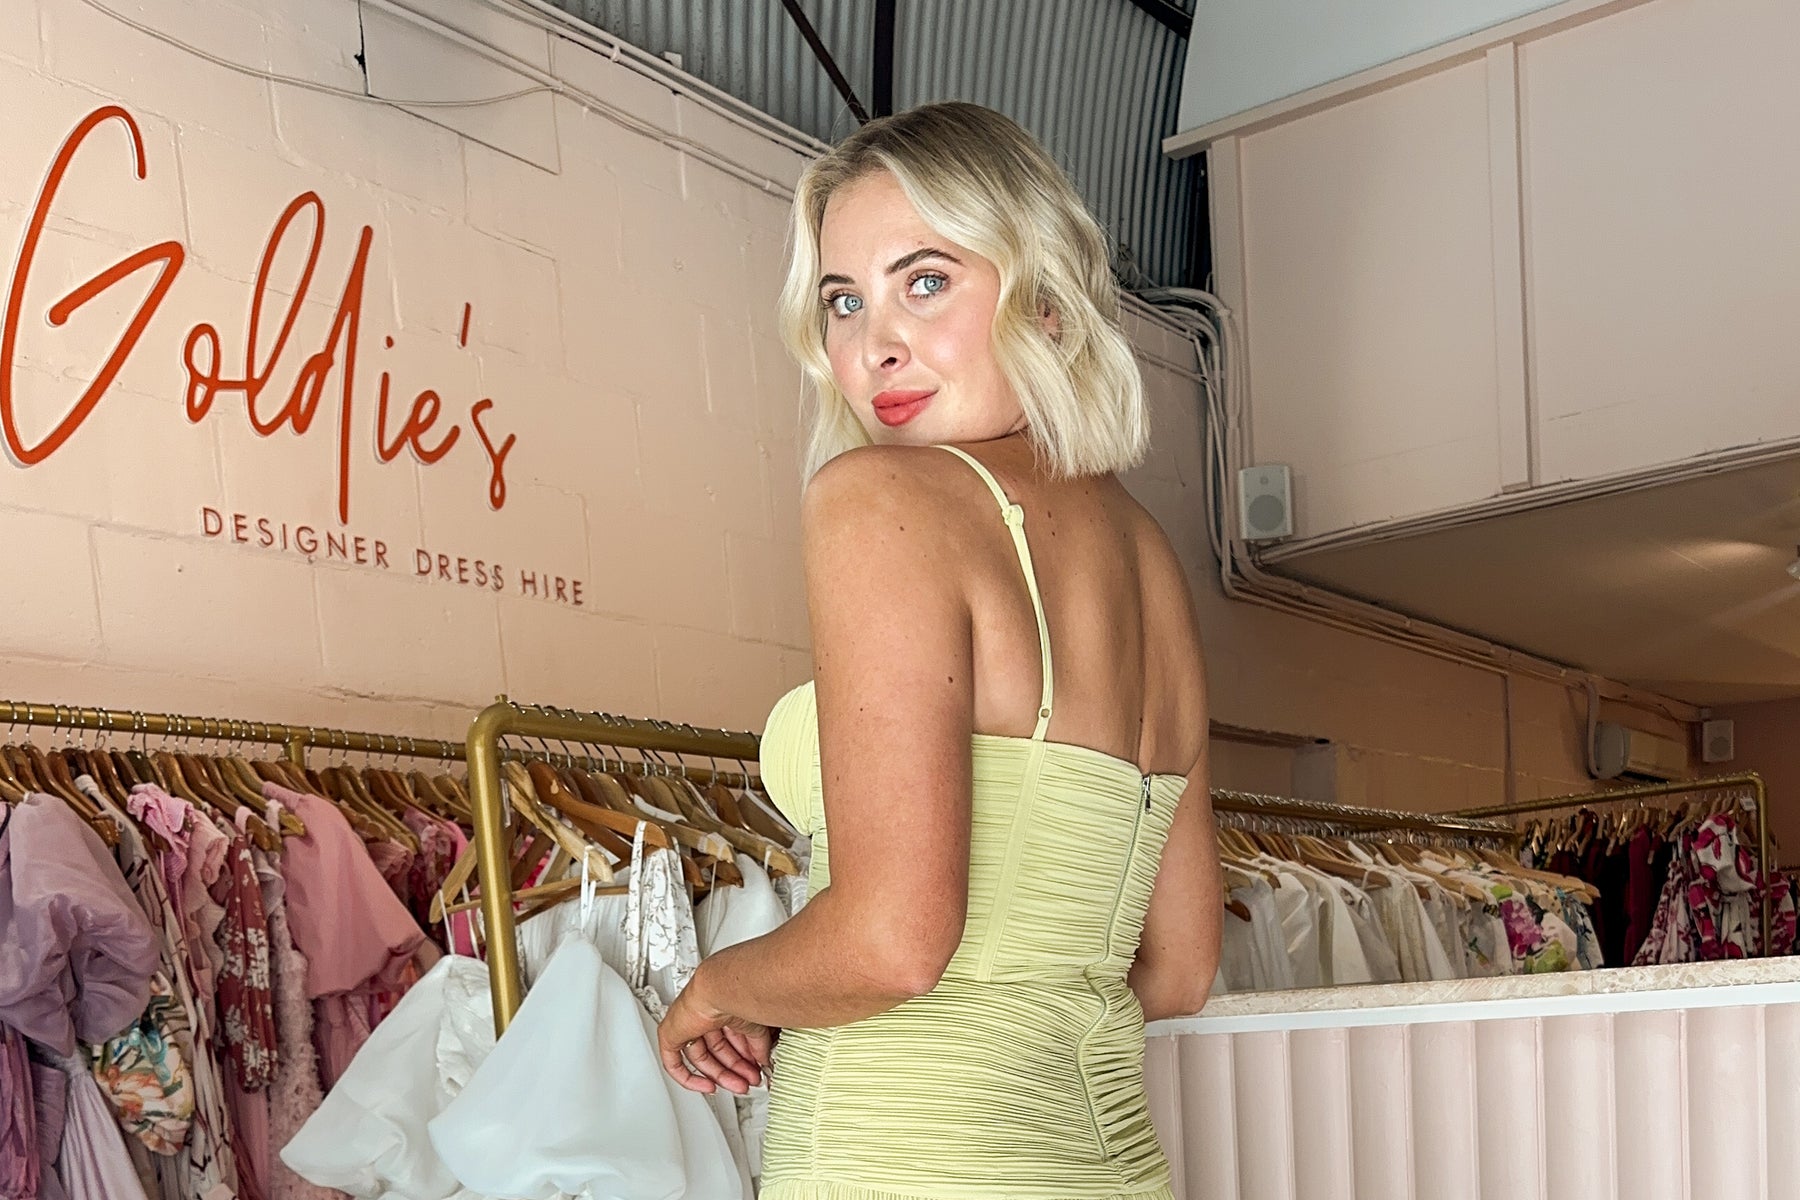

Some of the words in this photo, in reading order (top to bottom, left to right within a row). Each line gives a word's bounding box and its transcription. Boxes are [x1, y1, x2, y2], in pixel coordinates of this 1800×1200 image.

[0, 105, 517, 525] Goldie's
[201, 507, 390, 568] DESIGNER
[416, 549, 505, 592] DRESS
[520, 570, 586, 606] HIRE
